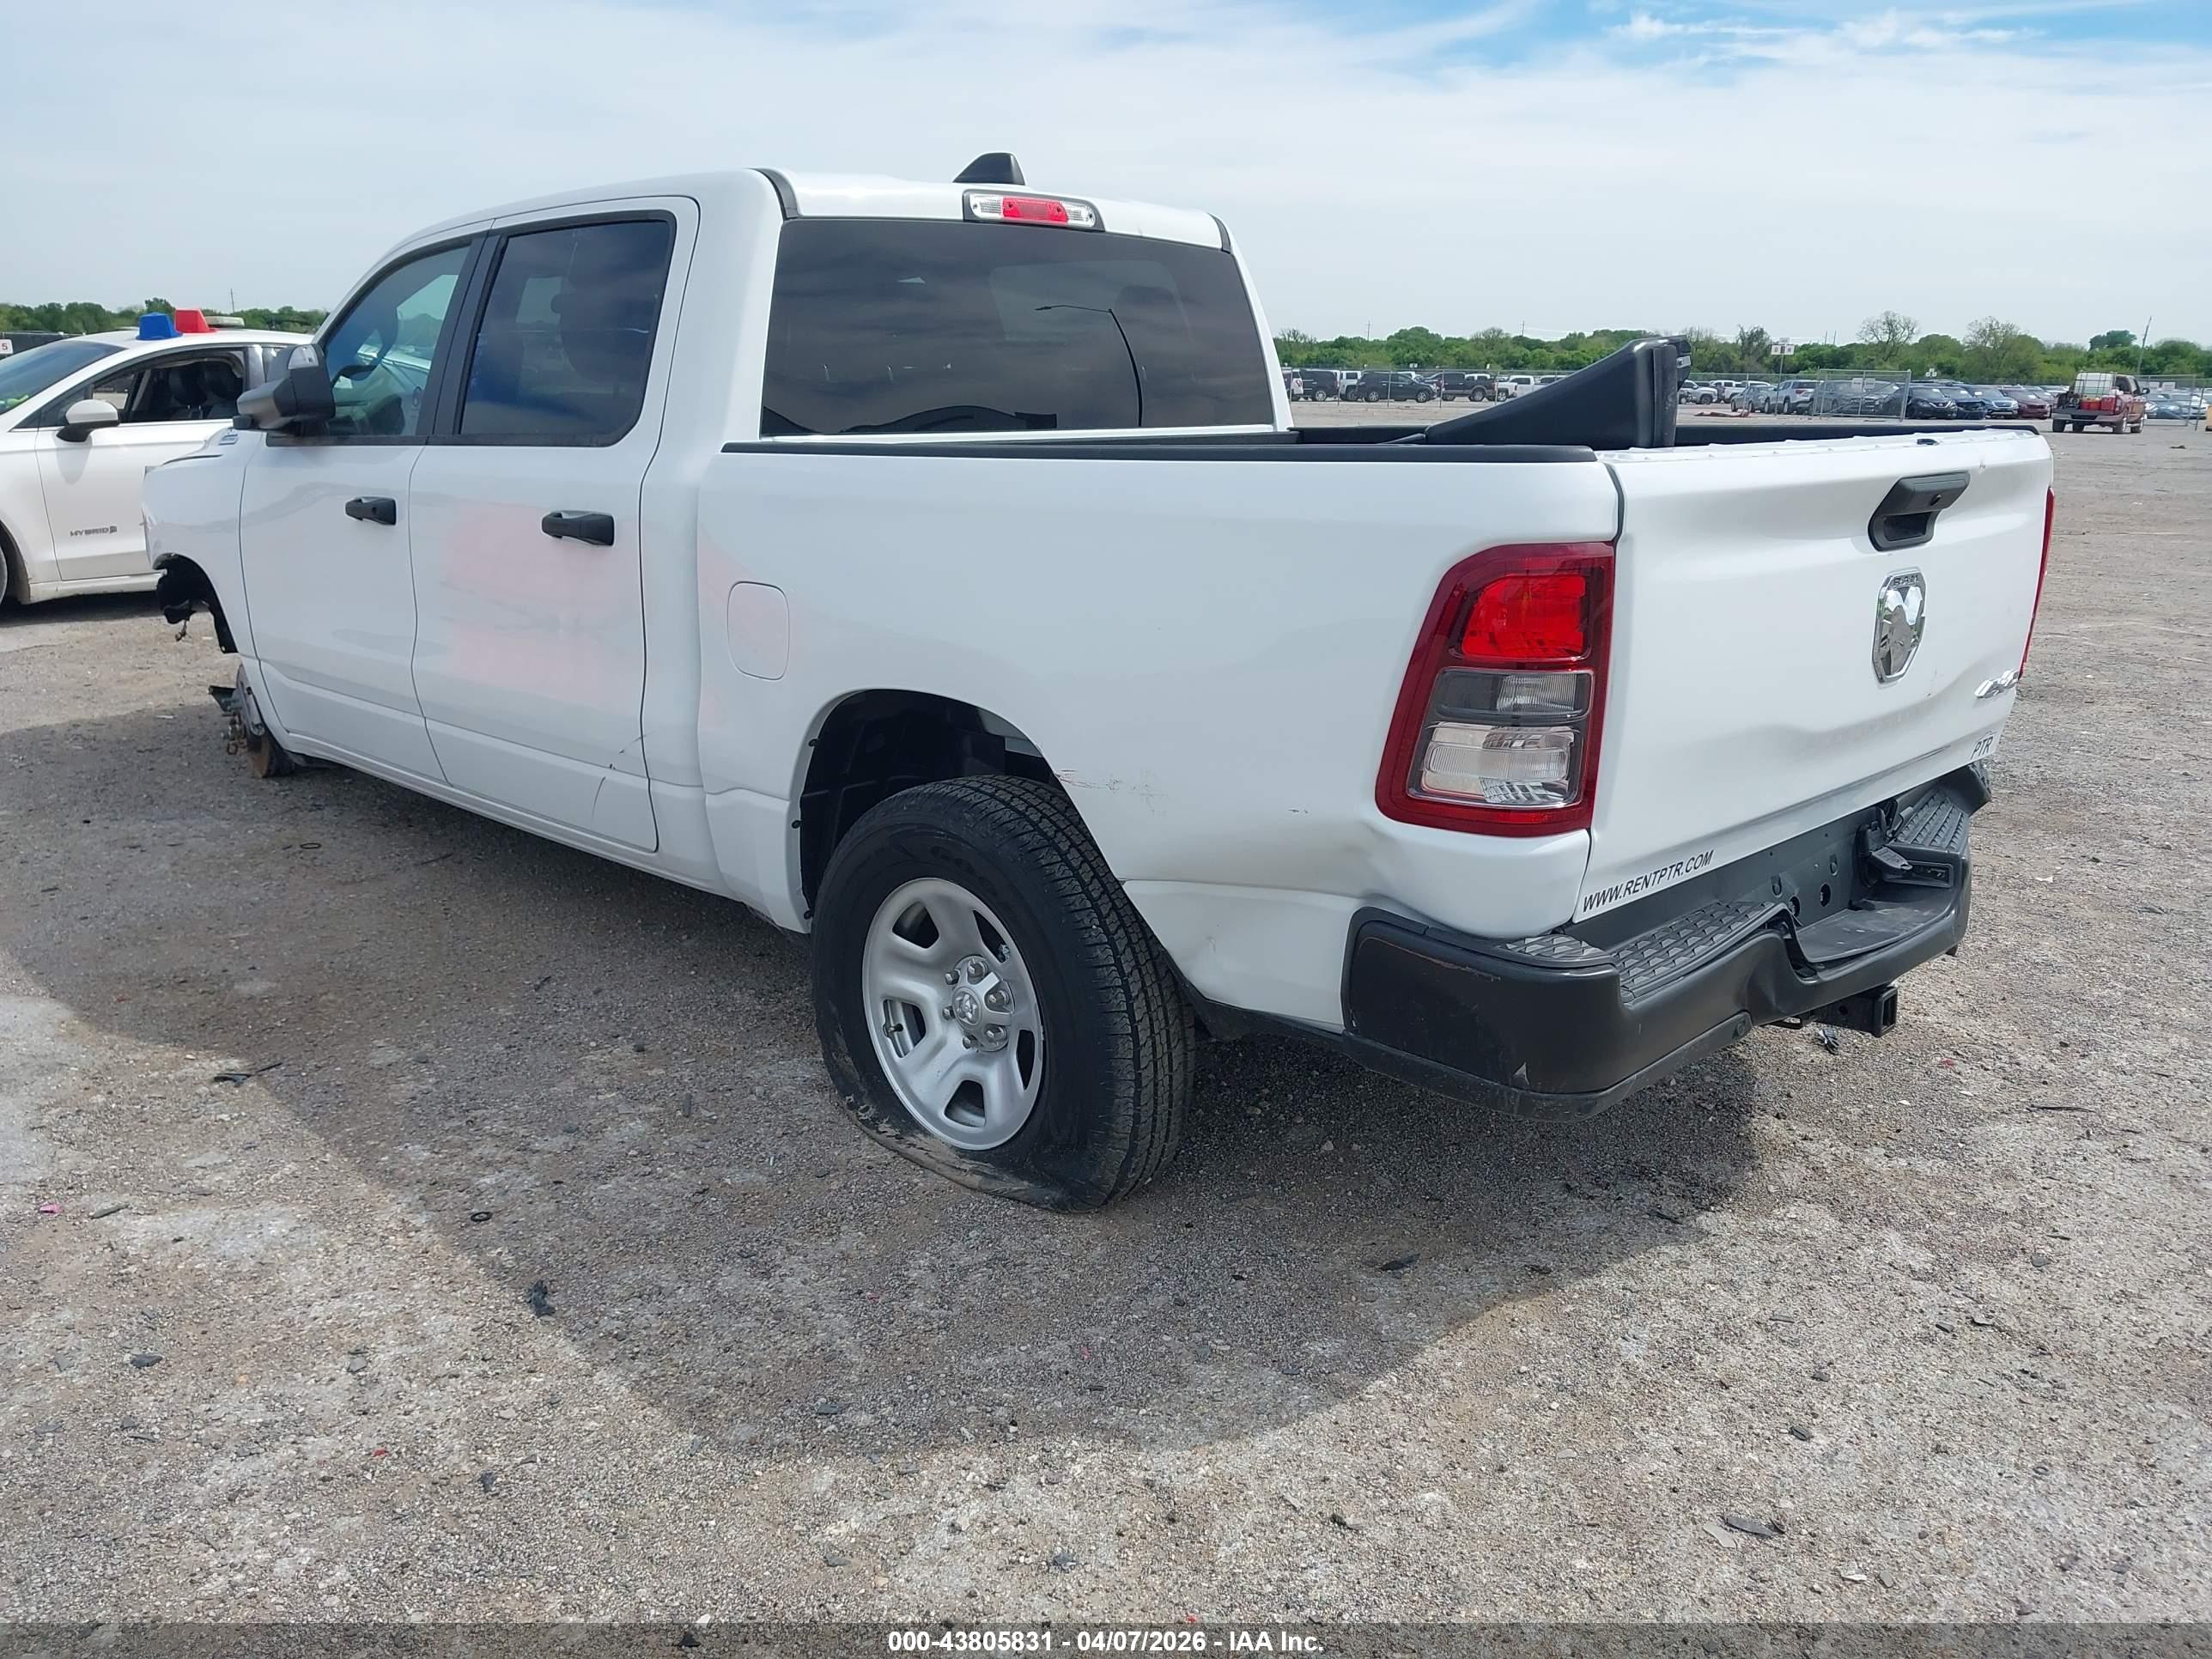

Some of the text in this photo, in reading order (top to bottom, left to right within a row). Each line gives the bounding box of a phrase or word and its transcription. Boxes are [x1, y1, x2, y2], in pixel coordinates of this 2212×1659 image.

[70, 526, 109, 537] HYBRID
[1893, 573, 1918, 586] RAM
[1970, 734, 1995, 761] PTR
[1583, 849, 1715, 913] WWW.RENTPTR.COM
